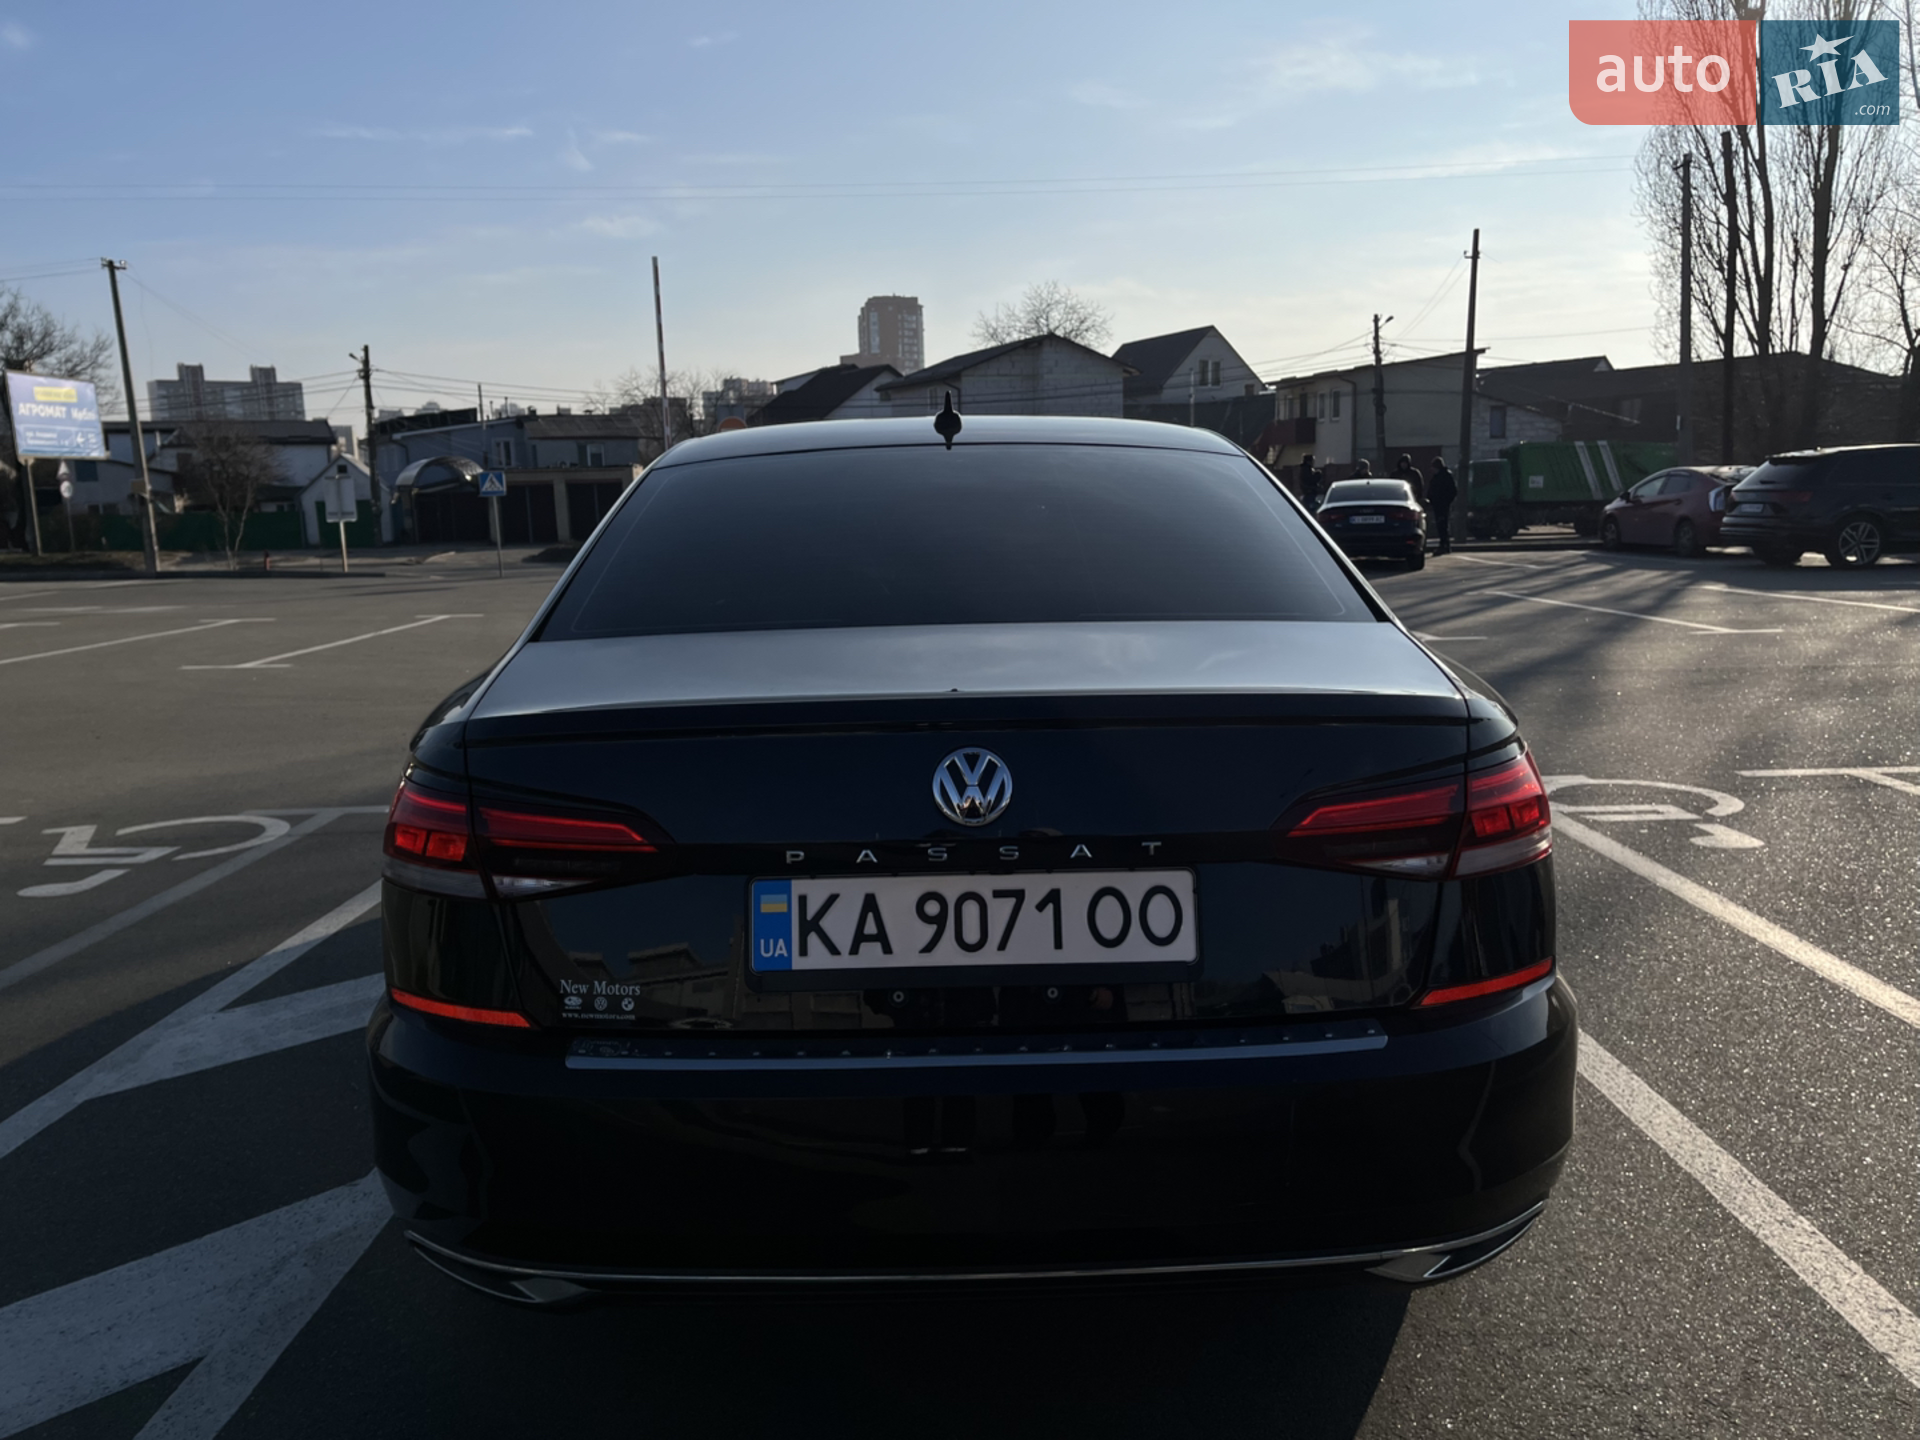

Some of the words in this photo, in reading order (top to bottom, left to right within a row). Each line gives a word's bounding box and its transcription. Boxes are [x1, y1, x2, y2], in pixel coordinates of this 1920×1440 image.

[18, 403, 67, 419] АГРОМАТ
[785, 841, 1162, 865] PASSAT
[797, 892, 893, 958] KA
[914, 887, 1064, 955] 9071
[1086, 884, 1184, 949] OO
[760, 938, 788, 958] UA
[559, 979, 589, 994] New
[593, 980, 641, 996] Motors
[562, 1012, 635, 1020] www.newmotors.com
